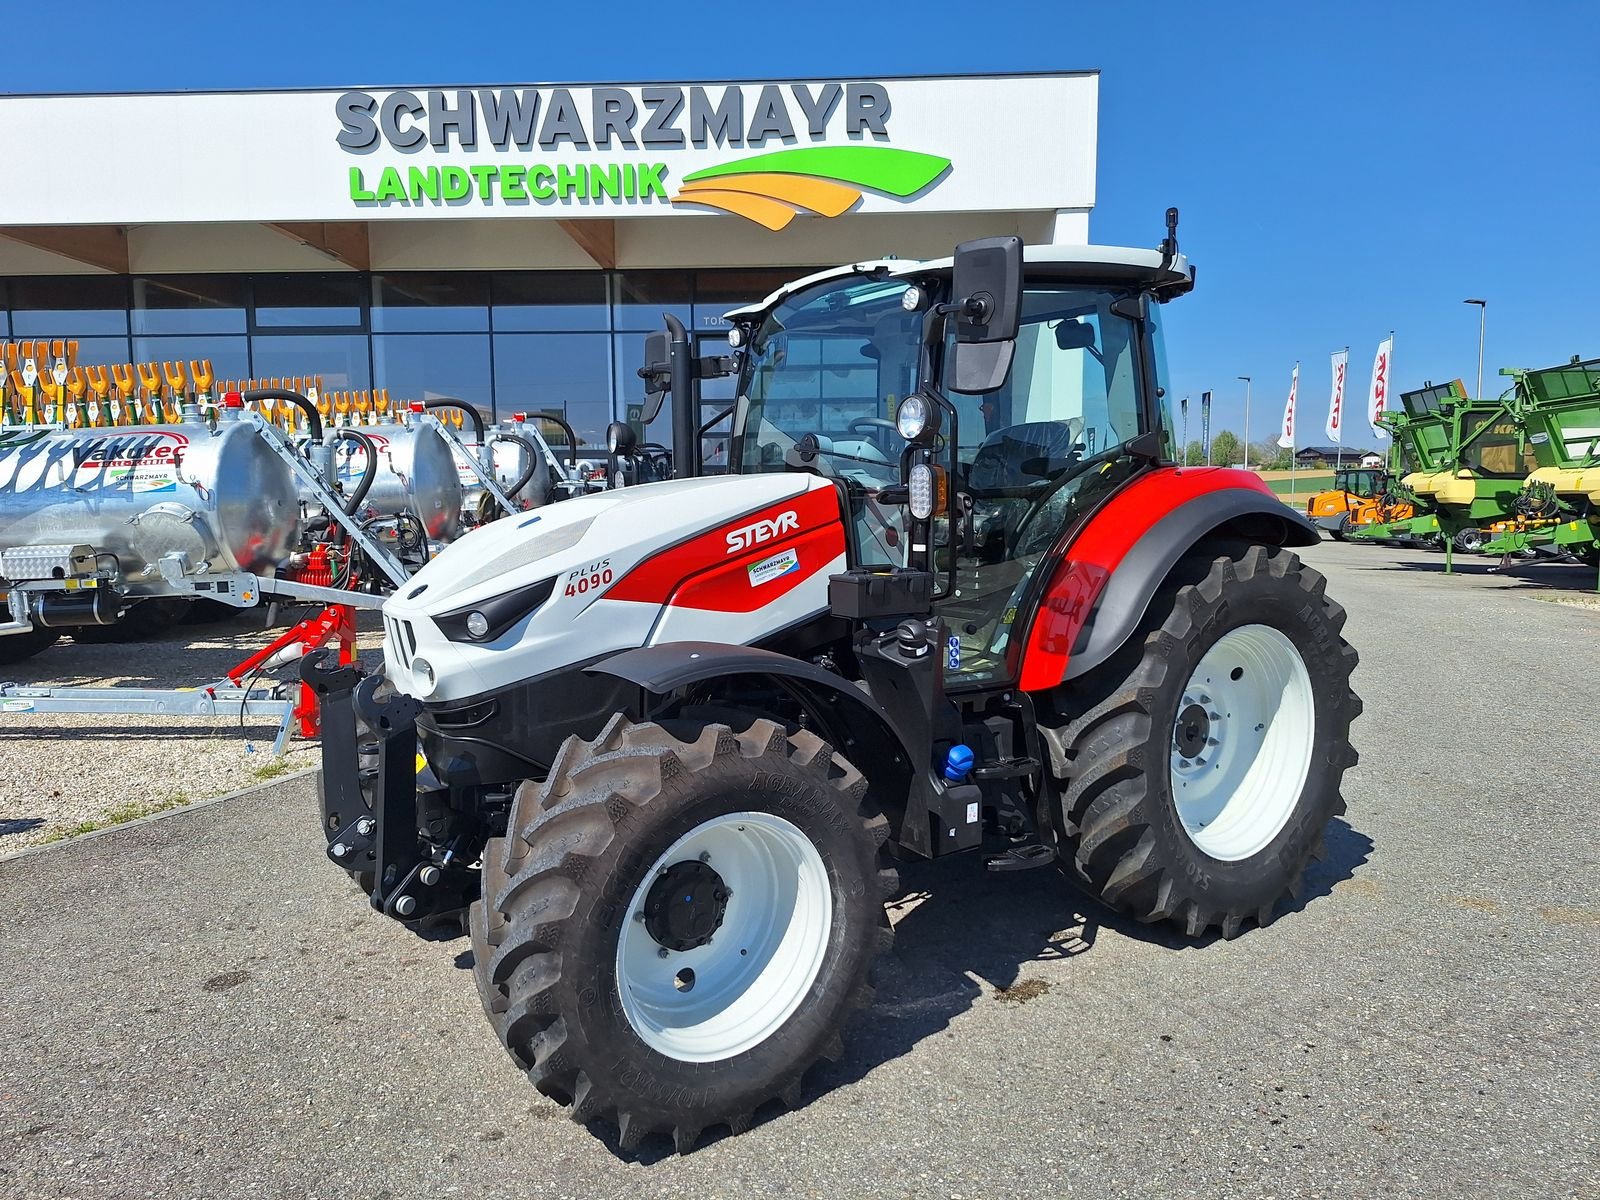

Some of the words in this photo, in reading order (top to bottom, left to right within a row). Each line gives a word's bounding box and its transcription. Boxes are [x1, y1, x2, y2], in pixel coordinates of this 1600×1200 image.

[336, 83, 889, 151] SCHWARZMAYR
[349, 163, 669, 204] LANDTECHNIK
[73, 442, 187, 468] Vakutec
[115, 473, 168, 481] SCHWARZMAYR
[726, 510, 800, 555] STEYR
[568, 557, 611, 582] PLUS
[752, 555, 790, 574] SCHWARZMAYR
[564, 568, 613, 597] 4090
